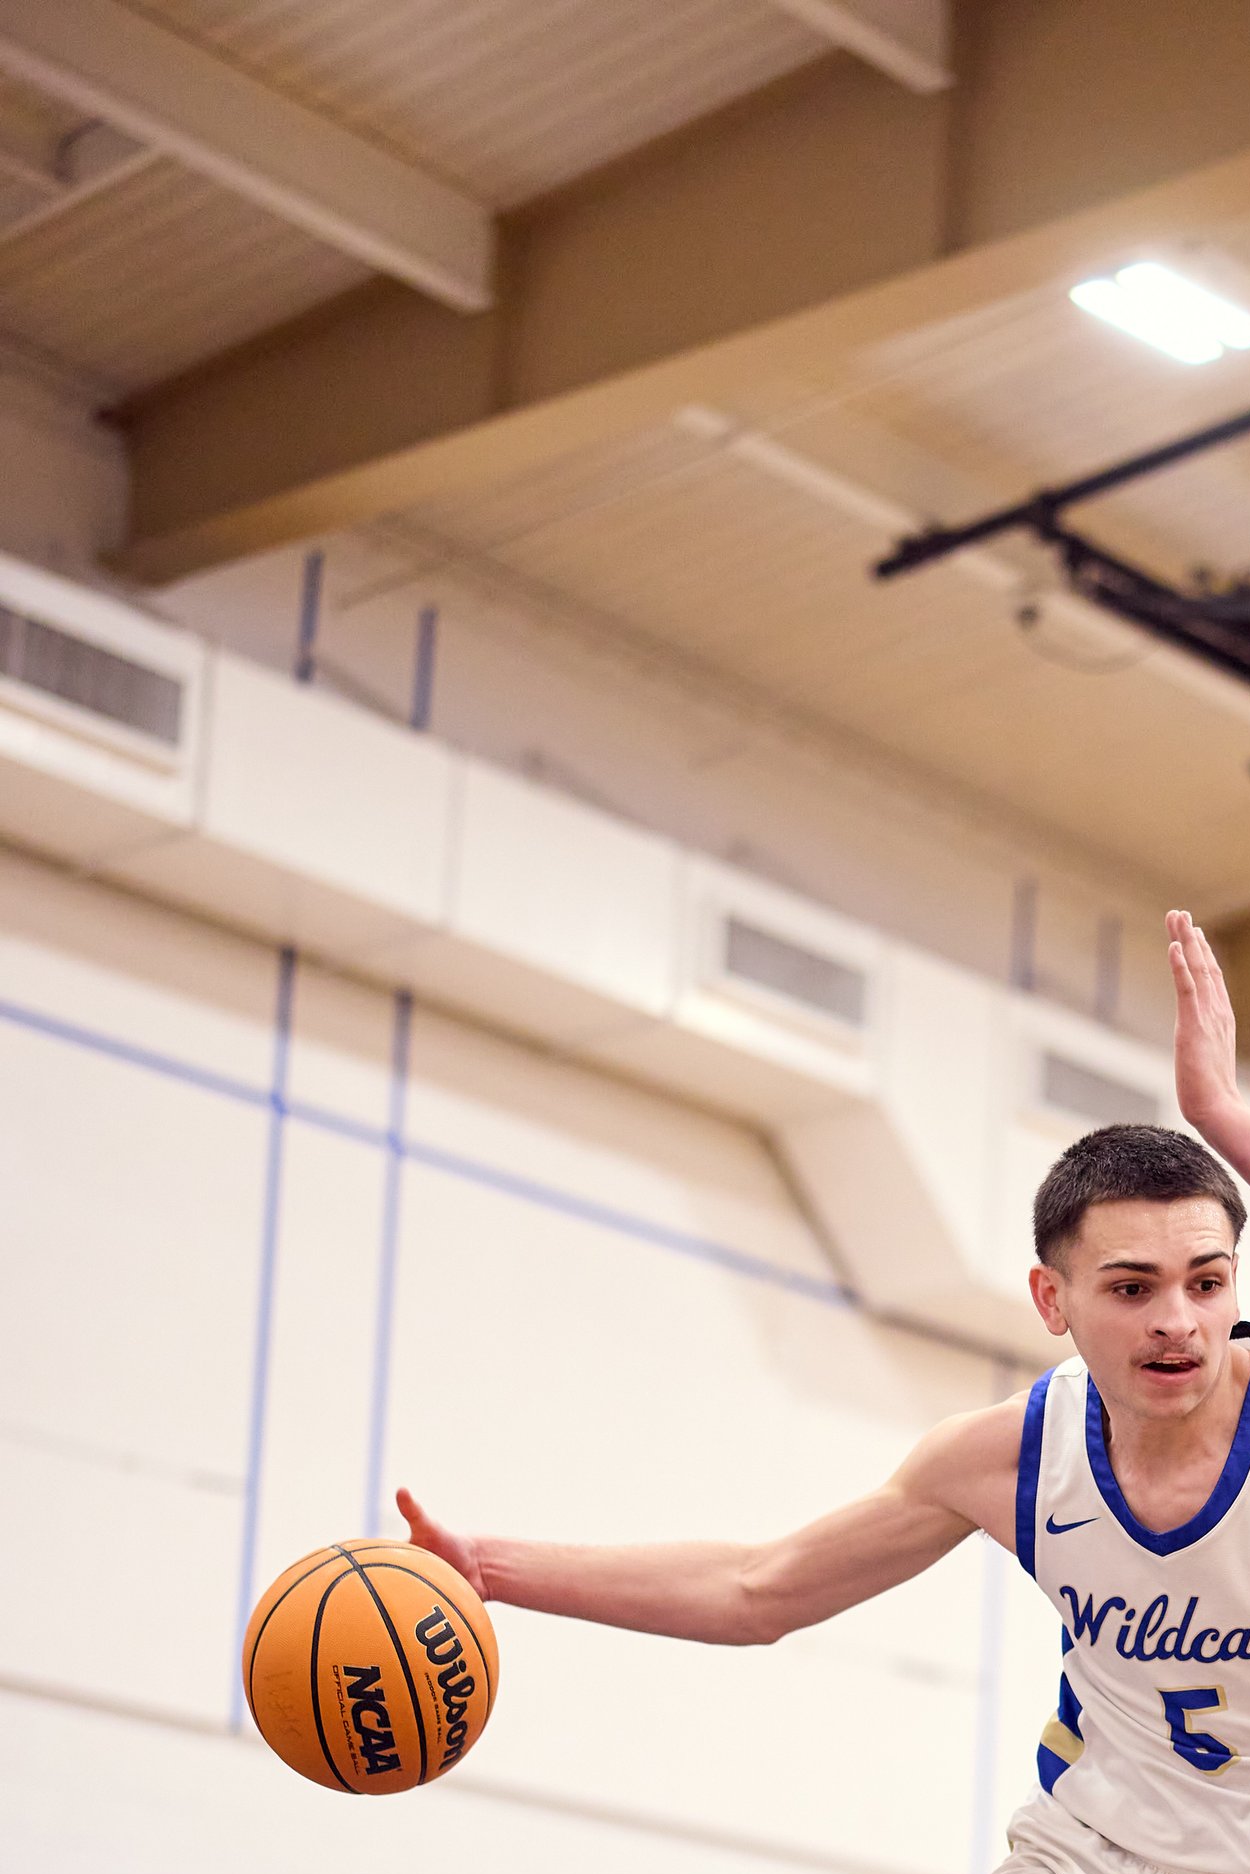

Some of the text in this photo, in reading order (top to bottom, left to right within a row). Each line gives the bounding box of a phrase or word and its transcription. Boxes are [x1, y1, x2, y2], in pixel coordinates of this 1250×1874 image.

[332, 1664, 360, 1776] OFFICIAL GAME BALL
[342, 1665, 401, 1776] NCAA
[414, 1603, 476, 1771] Wilson
[424, 1671, 437, 1702] INDOOR
[1158, 1684, 1240, 1777] 5
